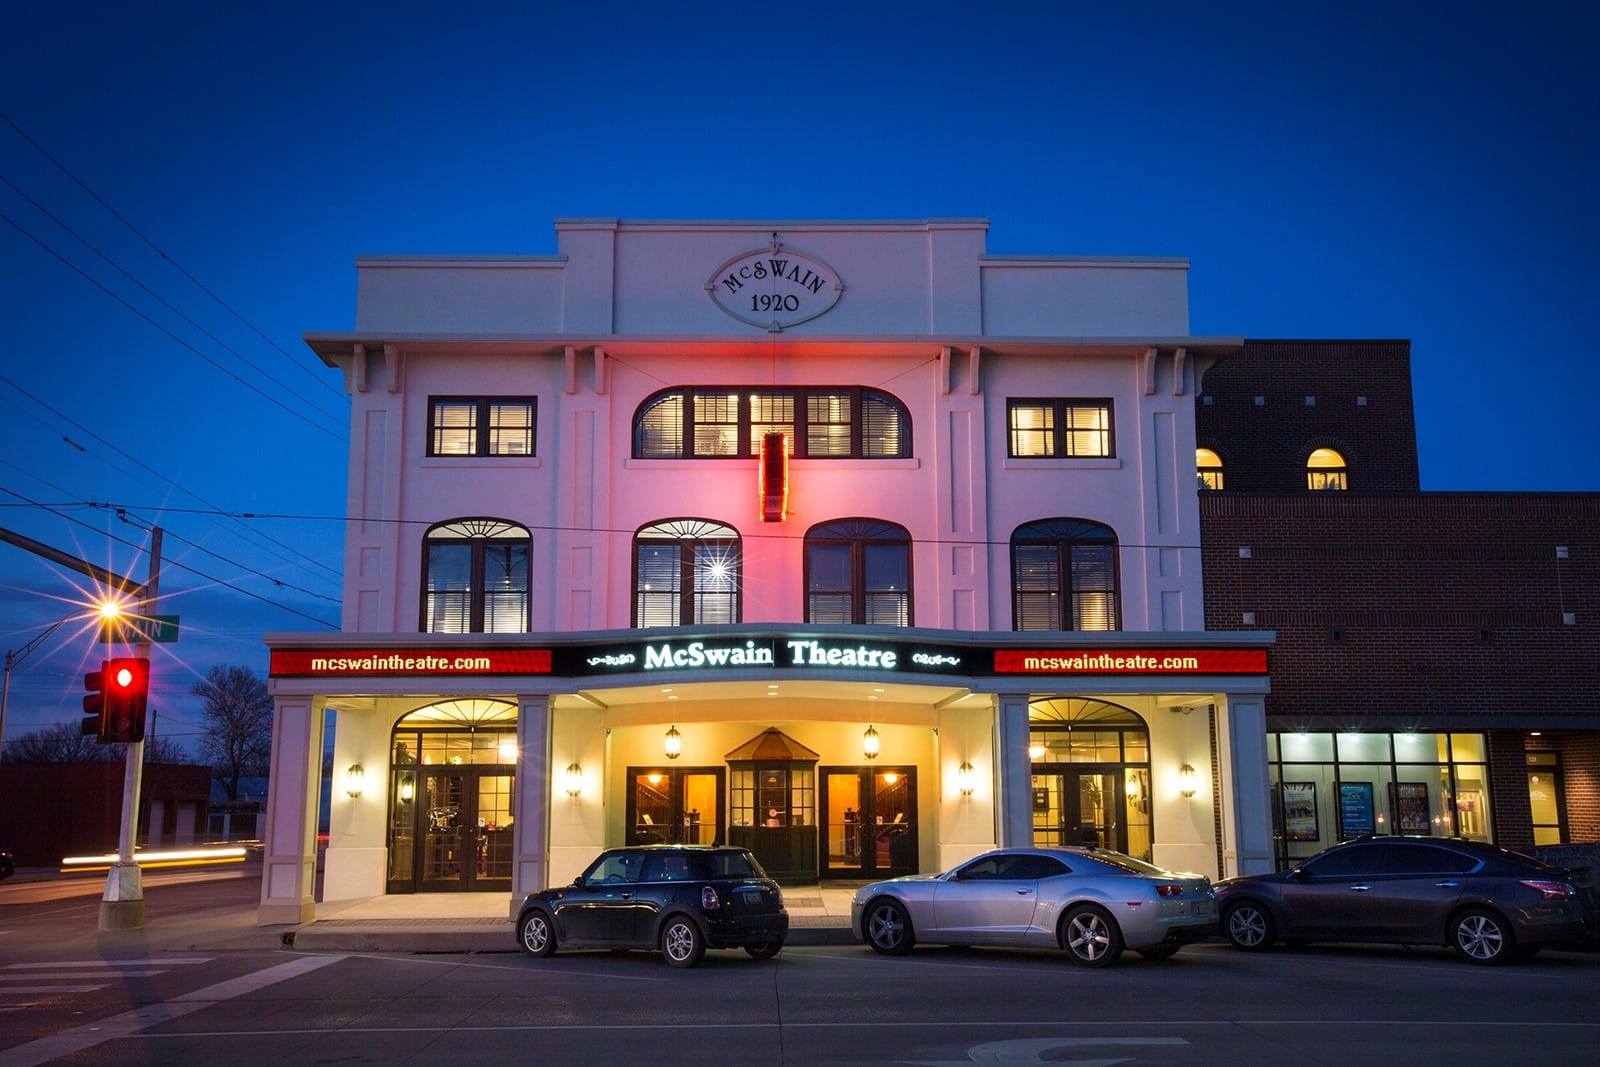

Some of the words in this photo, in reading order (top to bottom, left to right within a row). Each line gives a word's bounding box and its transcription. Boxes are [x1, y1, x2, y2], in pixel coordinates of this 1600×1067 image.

[751, 294, 799, 312] 1920
[311, 654, 491, 671] mcswaintheatre.com
[644, 641, 774, 669] McSwain
[787, 640, 897, 668] Theatre
[1024, 653, 1199, 669] mcswaintheatre.com
